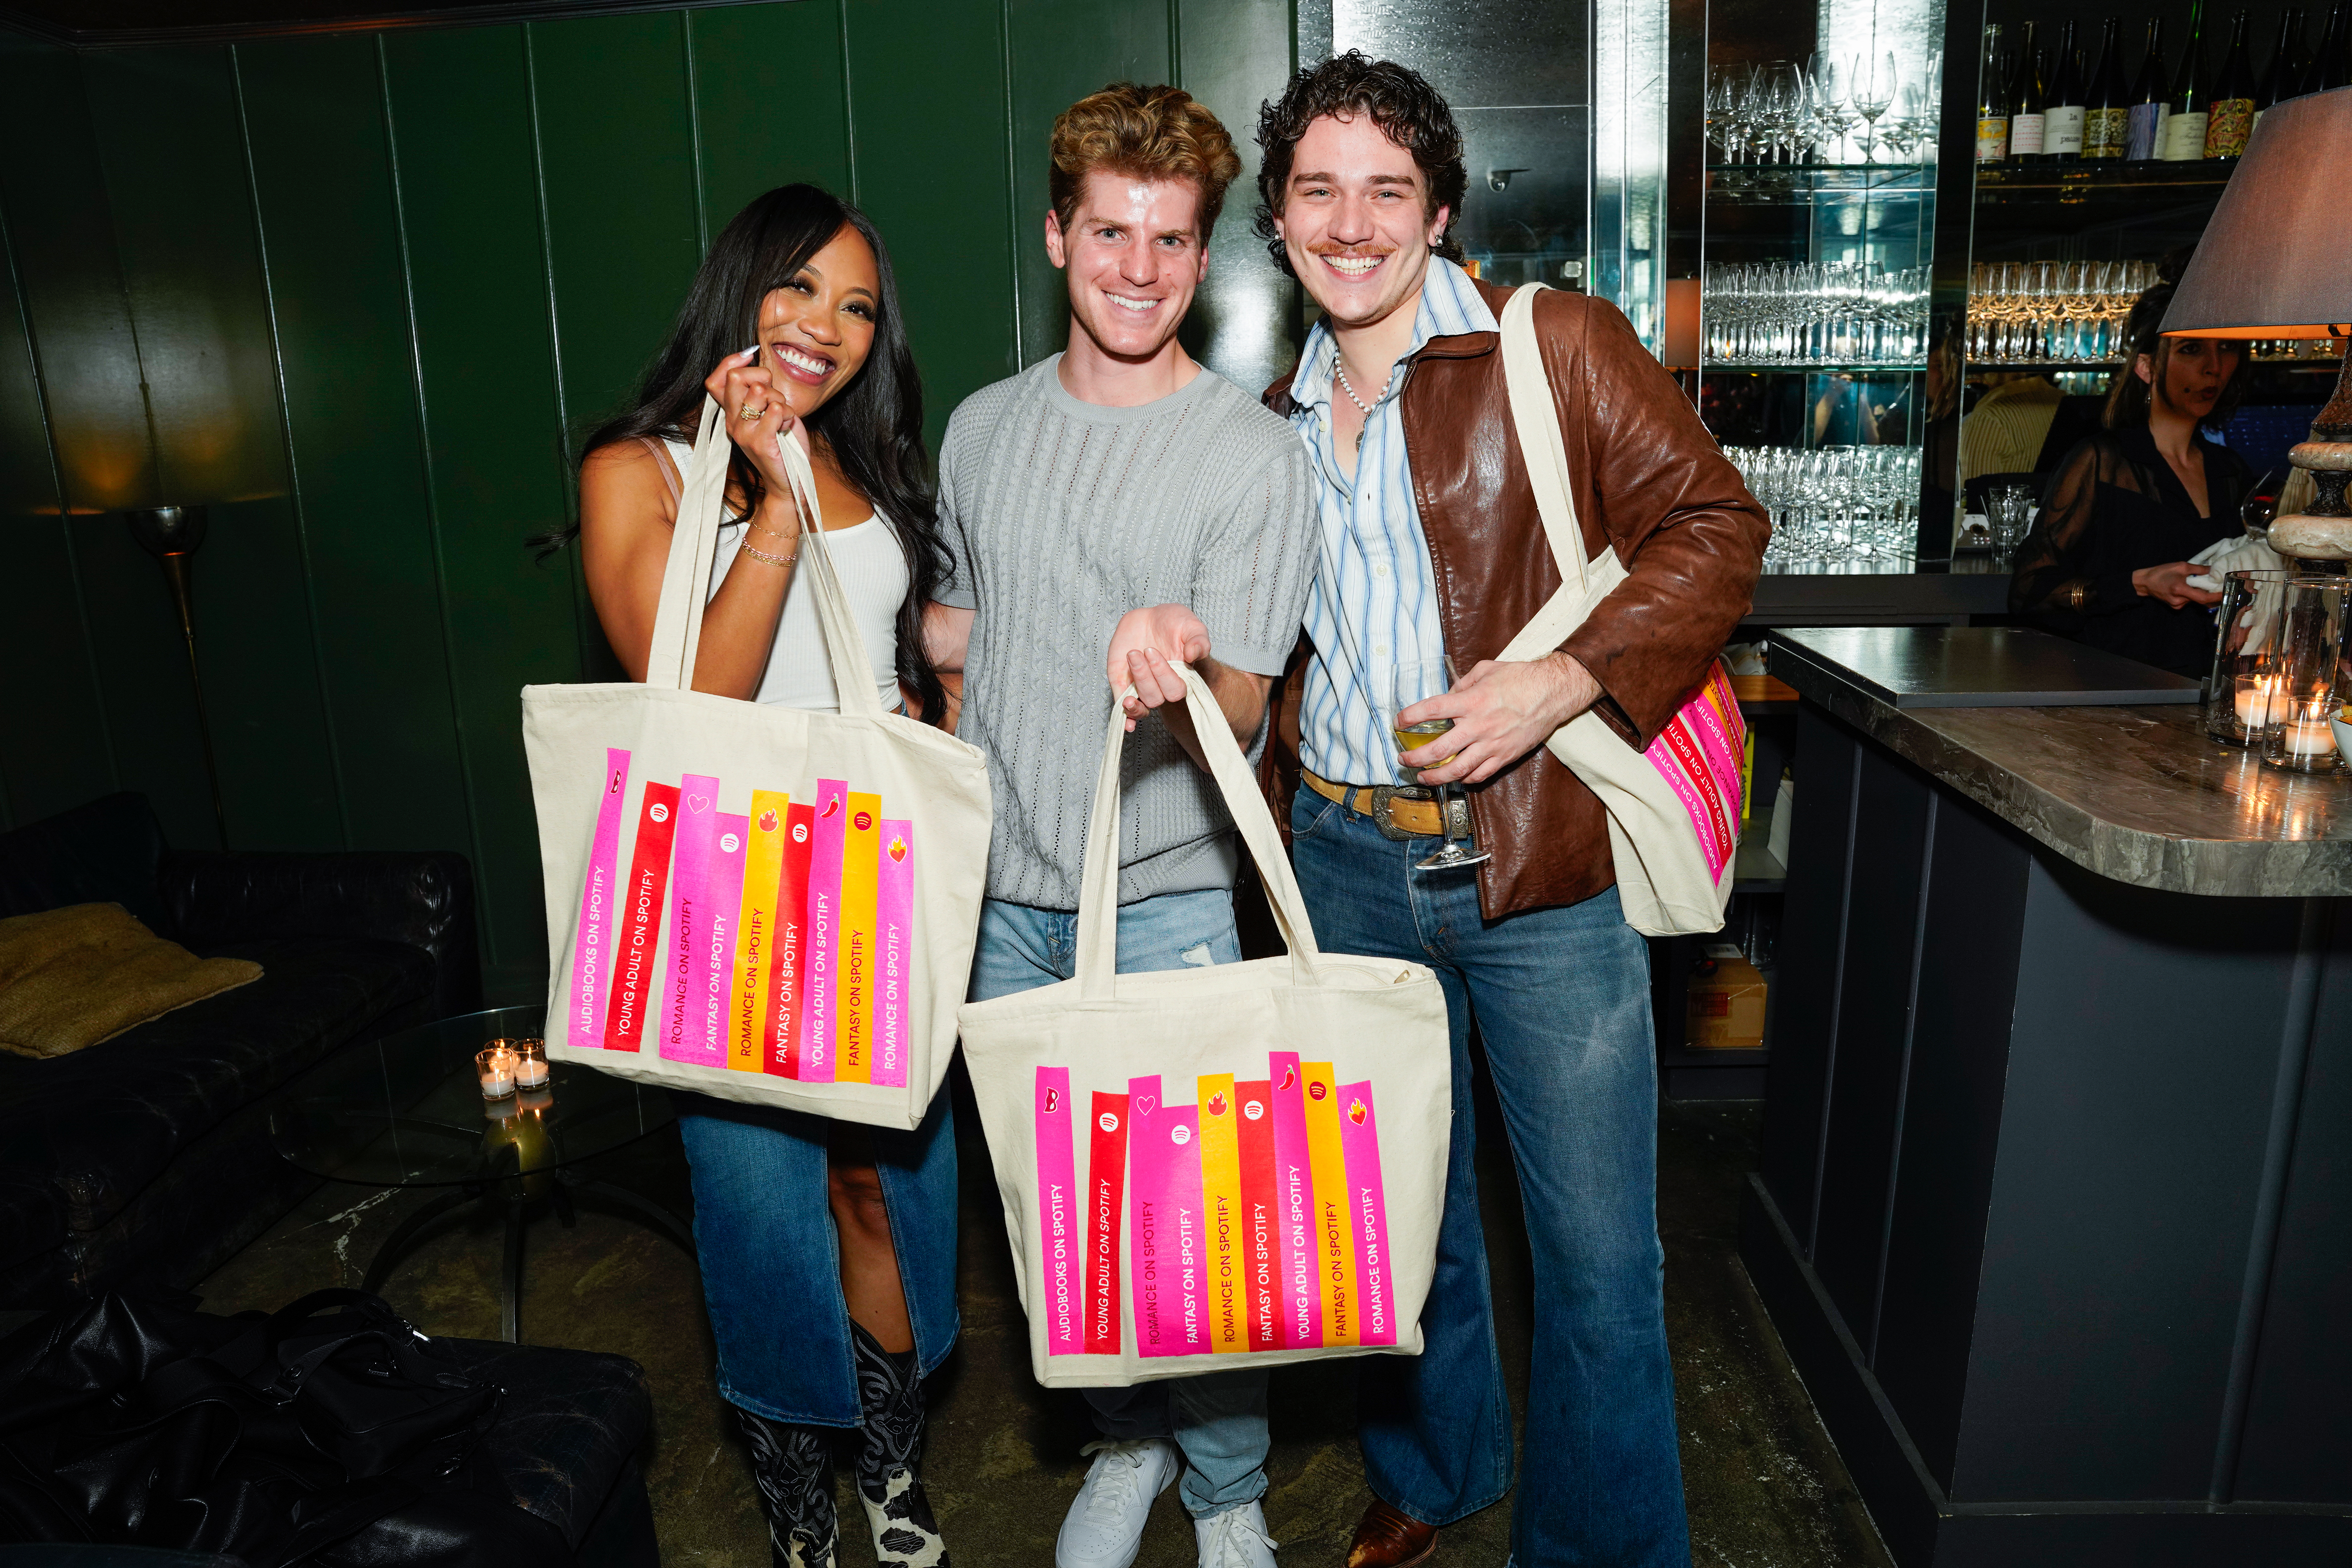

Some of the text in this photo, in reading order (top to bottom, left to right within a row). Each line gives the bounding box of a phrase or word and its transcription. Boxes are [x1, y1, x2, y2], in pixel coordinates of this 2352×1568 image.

[1666, 722, 1691, 758] SPOTIF
[1689, 757, 1702, 776] ON
[1693, 699, 1721, 738] SPOTIFY
[1706, 749, 1716, 767] ON
[1719, 736, 1730, 754] ON
[1650, 743, 1717, 870] AUDIOBOOKS ON SPOTIFY
[1700, 776, 1719, 809] ADULT
[1716, 809, 1727, 850] YOUNG
[581, 866, 604, 1034] AUDIOBOOKS ON SPOTIFY
[618, 869, 654, 1036] YOUNG ADULT ON SPOTIFY
[670, 897, 692, 1045] ROMANCE ON SPOTIFY
[706, 914, 727, 1051] FANTASY ON SPOTIFY
[740, 908, 763, 1057] ROMANCE ON SPOTIFY
[776, 922, 798, 1063] FANTASY ON SPOTIFY
[812, 892, 829, 1067] YOUNG ADULT ON SPOTIFY
[848, 930, 863, 1066] FANTASY ON SPOTIFY
[884, 923, 899, 1070] ROMANCE ON SPOTIFY
[1051, 1184, 1071, 1341] AUDIOBOOKS ON SPOTIFY
[1097, 1178, 1111, 1340] YOUNG ADULT ON SPOTIFY
[1142, 1201, 1161, 1345] ROMANCE ON SPOTIFY
[1179, 1208, 1198, 1343] FANTASY ON SPOTIFY
[1217, 1195, 1235, 1342] ROMANCE ON SPOTIFY
[1254, 1203, 1272, 1341] FANTASY ON SPOTIFY
[1289, 1165, 1310, 1339] YOUNG ADULT ON SPOTIFY
[1325, 1201, 1347, 1337] FANTASY ON SPOTIFY
[1361, 1187, 1384, 1333] ROMANCE ON SPOTIFY
